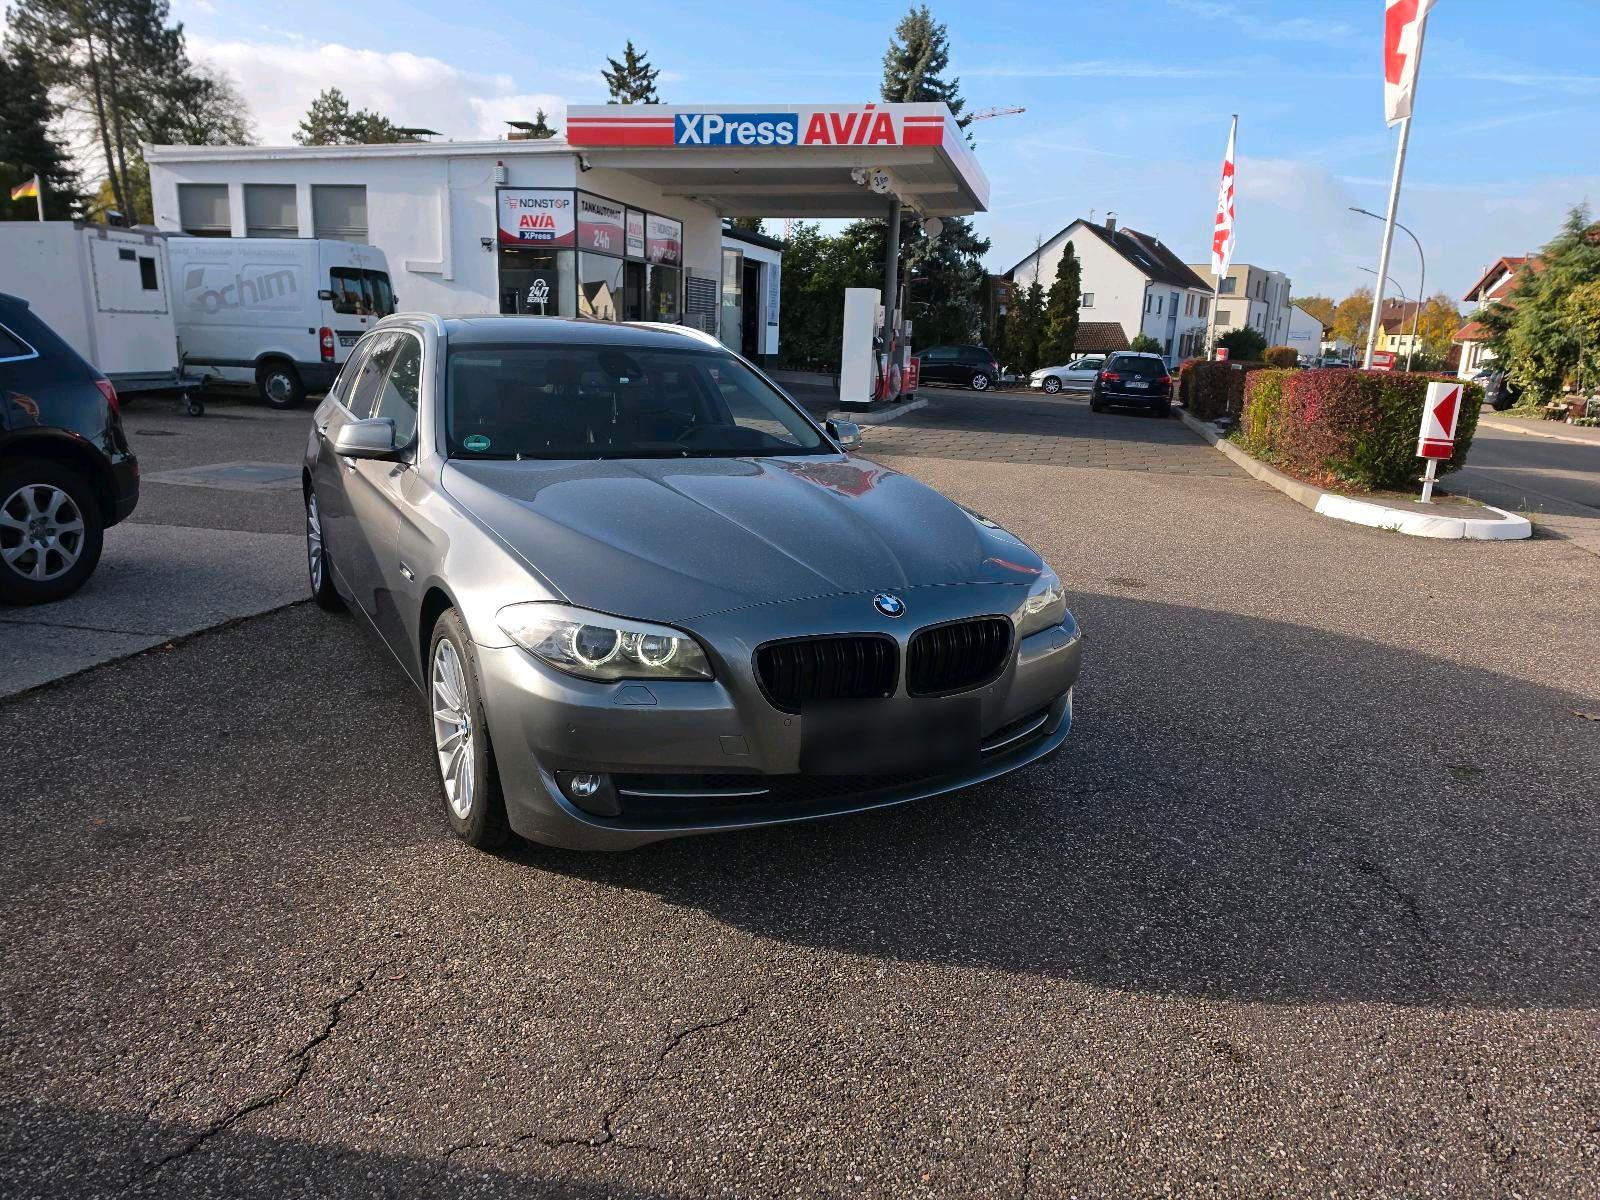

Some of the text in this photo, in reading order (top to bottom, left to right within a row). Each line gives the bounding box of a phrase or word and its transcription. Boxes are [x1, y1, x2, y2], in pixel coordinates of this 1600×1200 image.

[678, 114, 794, 145] XPress
[519, 198, 570, 209] NONSTOP
[581, 200, 622, 220] TANKAUTOMAT
[524, 231, 552, 240] XPress
[593, 229, 610, 249] 24h
[528, 286, 550, 297] 24/7
